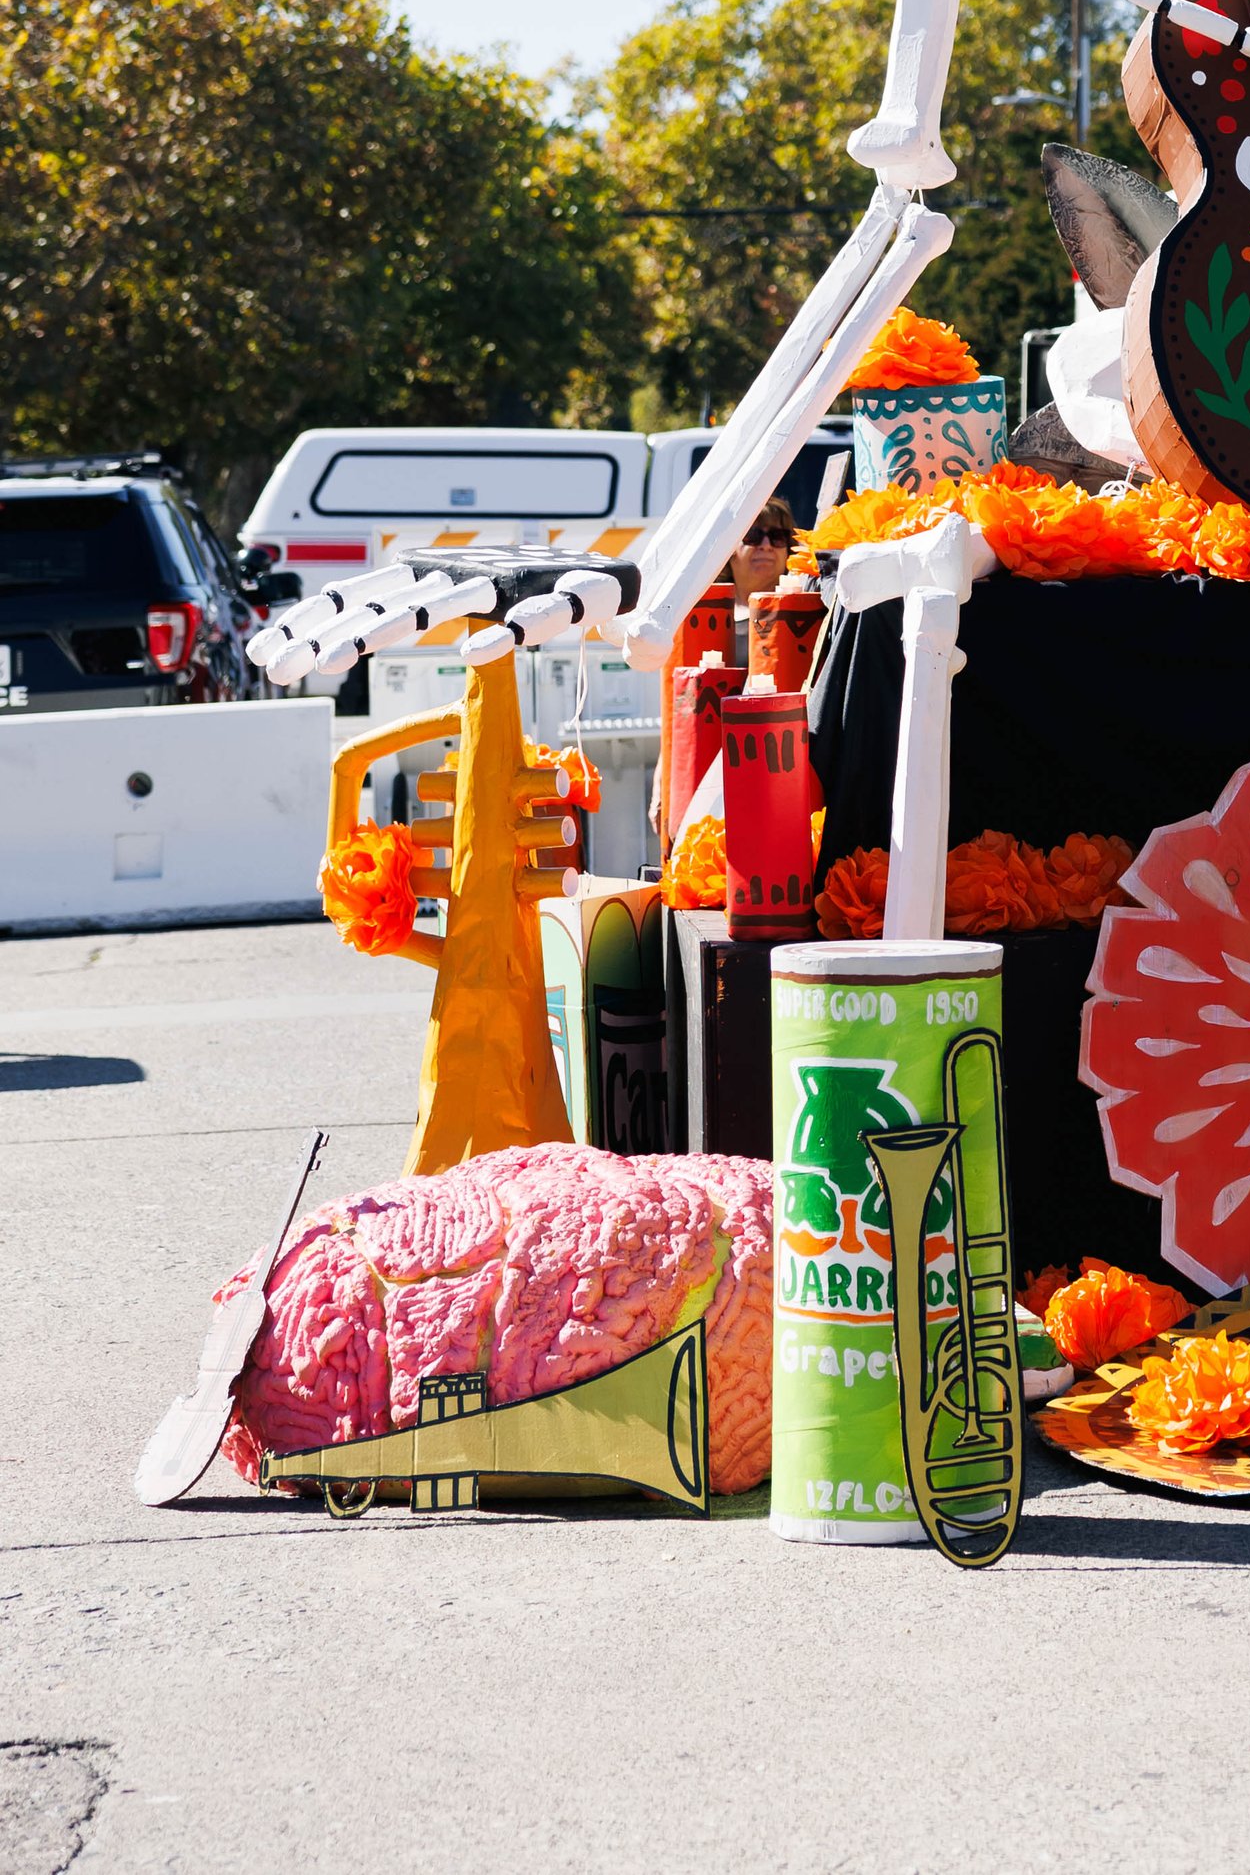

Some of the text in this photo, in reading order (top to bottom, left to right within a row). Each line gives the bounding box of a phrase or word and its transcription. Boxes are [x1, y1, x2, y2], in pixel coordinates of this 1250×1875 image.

[777, 985, 979, 1026] SUPER GOOD 1950
[781, 1255, 958, 1312] JARROS
